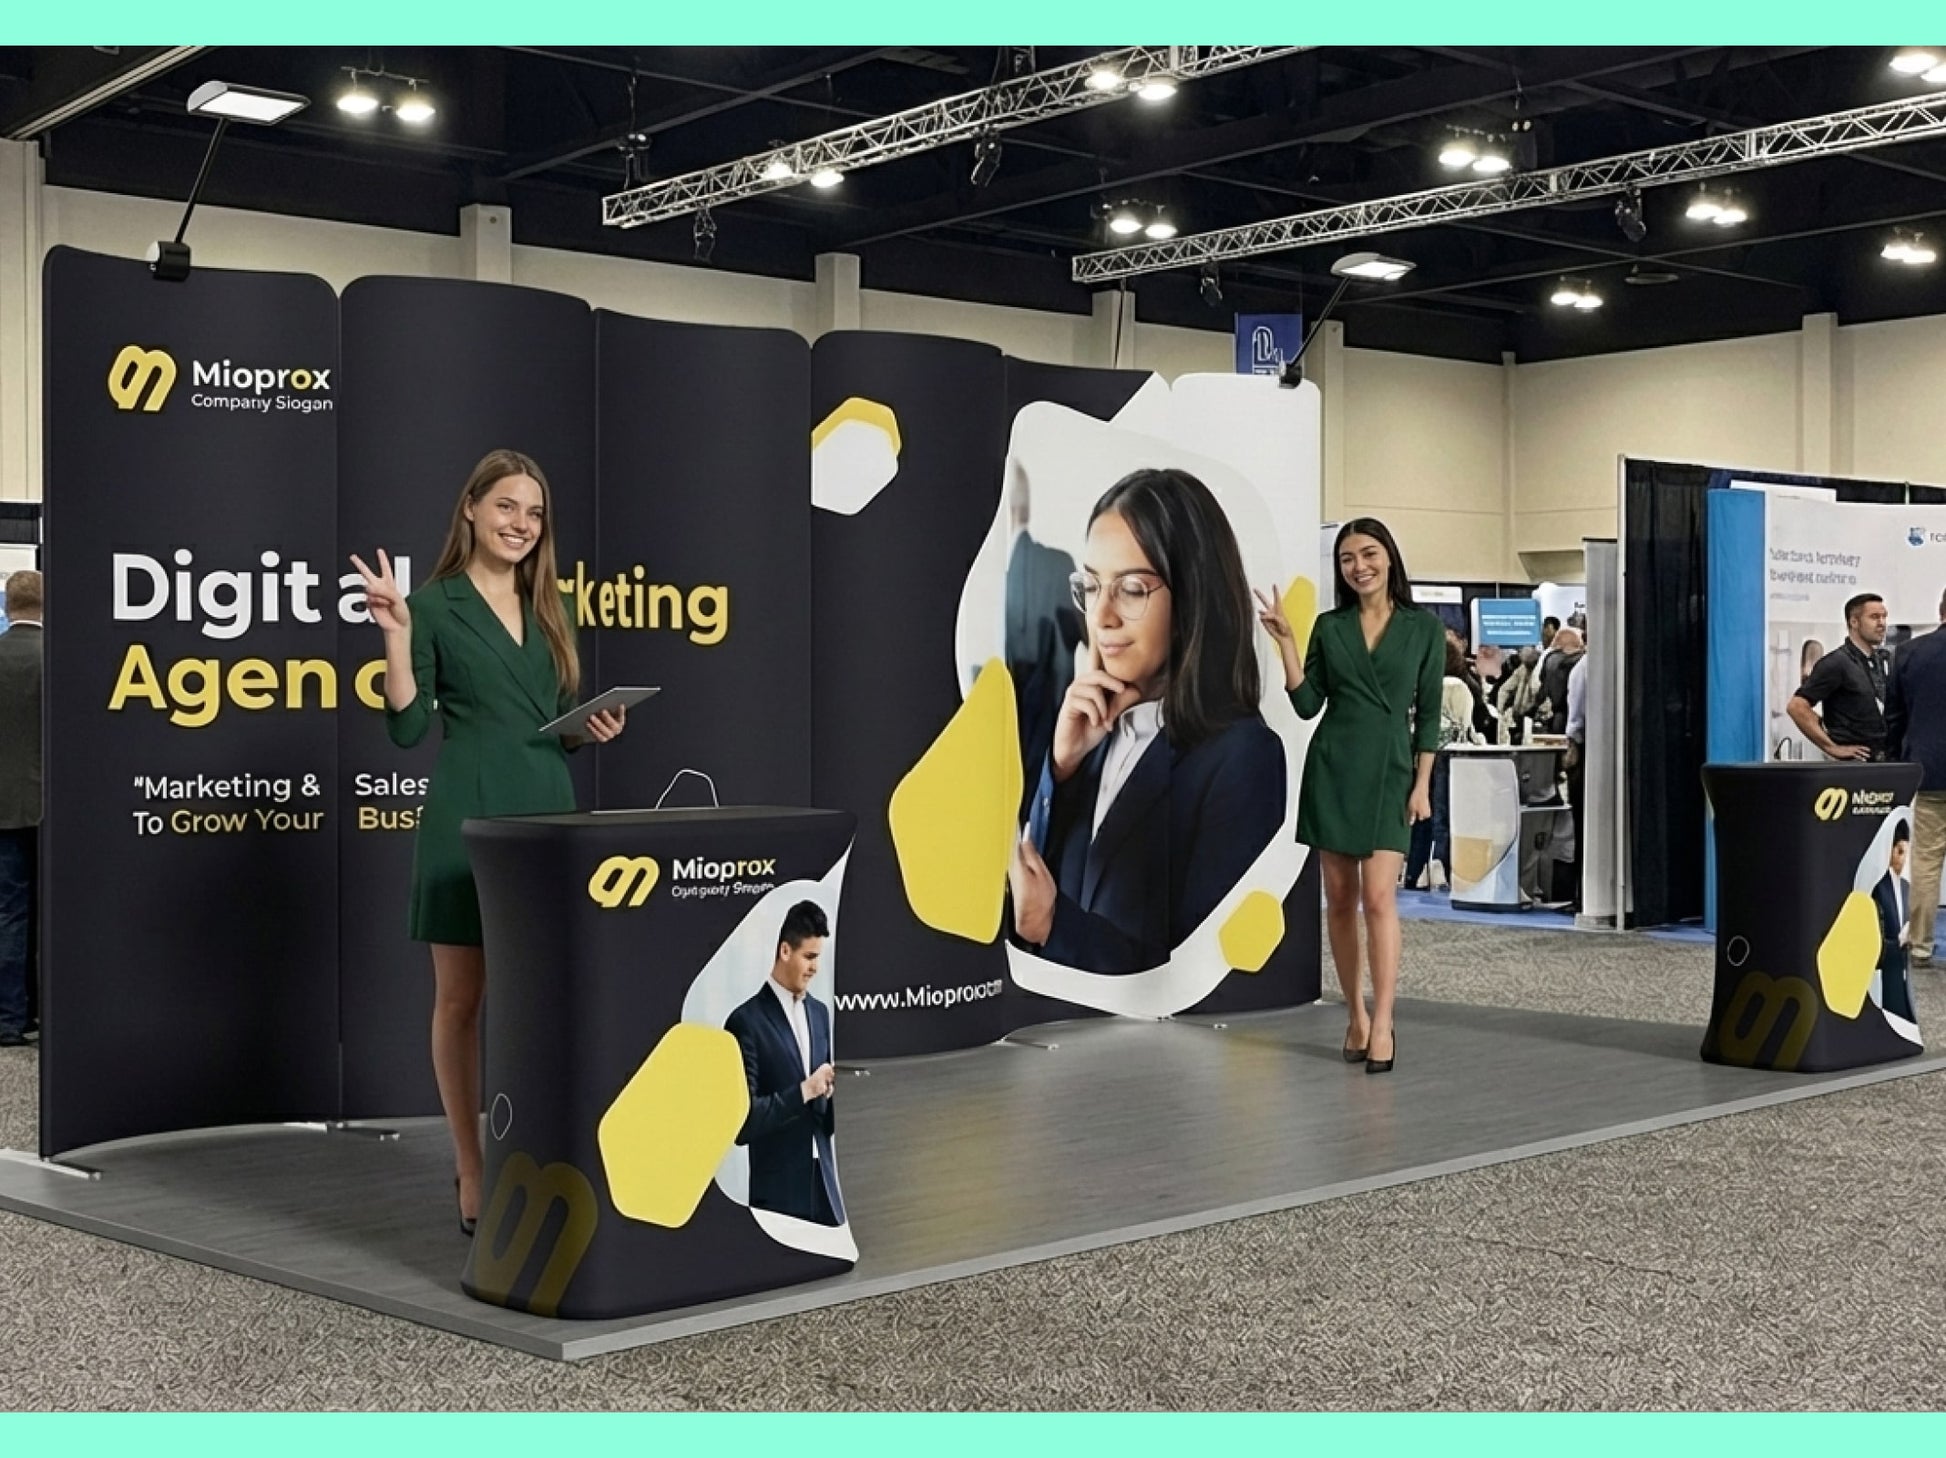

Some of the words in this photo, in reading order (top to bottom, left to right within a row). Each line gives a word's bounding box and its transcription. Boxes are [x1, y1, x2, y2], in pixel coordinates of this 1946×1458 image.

[192, 358, 331, 395] Mioprox
[191, 393, 273, 413] Company
[107, 644, 388, 728] Agenc
[301, 774, 320, 796] &
[354, 772, 429, 796] Sales
[132, 811, 164, 835] To
[171, 808, 247, 833] Grow
[254, 807, 324, 831] Your
[672, 856, 776, 883] Mioprox
